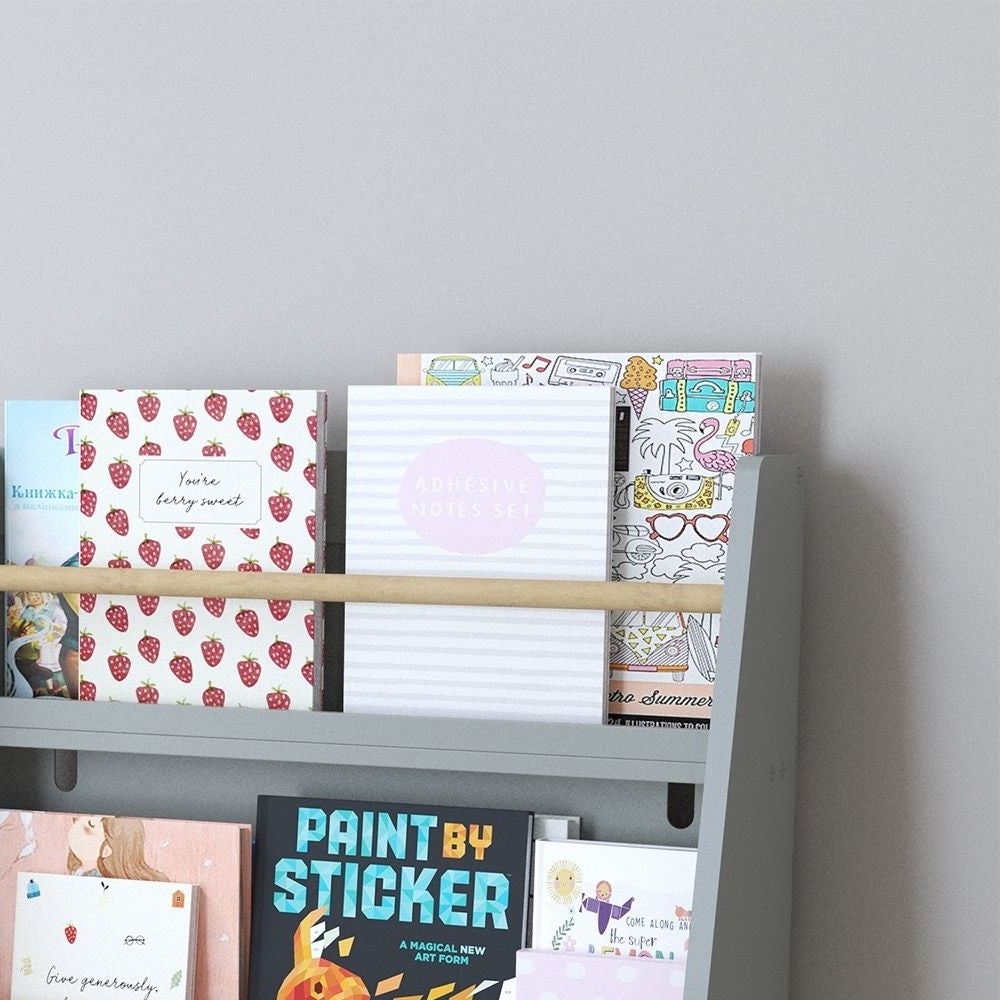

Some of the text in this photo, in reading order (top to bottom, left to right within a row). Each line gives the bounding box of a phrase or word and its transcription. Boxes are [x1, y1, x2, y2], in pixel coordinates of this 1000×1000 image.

[179, 470, 221, 487] You're
[415, 477, 529, 494] ADHESIVE
[156, 492, 244, 513] berry sweet
[412, 502, 530, 519] NOTES SET
[639, 690, 712, 707] Summer
[296, 807, 493, 861] PAINT BY
[273, 857, 510, 930] STICKER
[626, 917, 645, 927] COME
[650, 919, 675, 931] ALONG
[610, 928, 658, 949] the super
[399, 940, 486, 956] A MAGICAL NEW
[414, 952, 469, 965] ART FORM
[46, 965, 79, 985] Give
